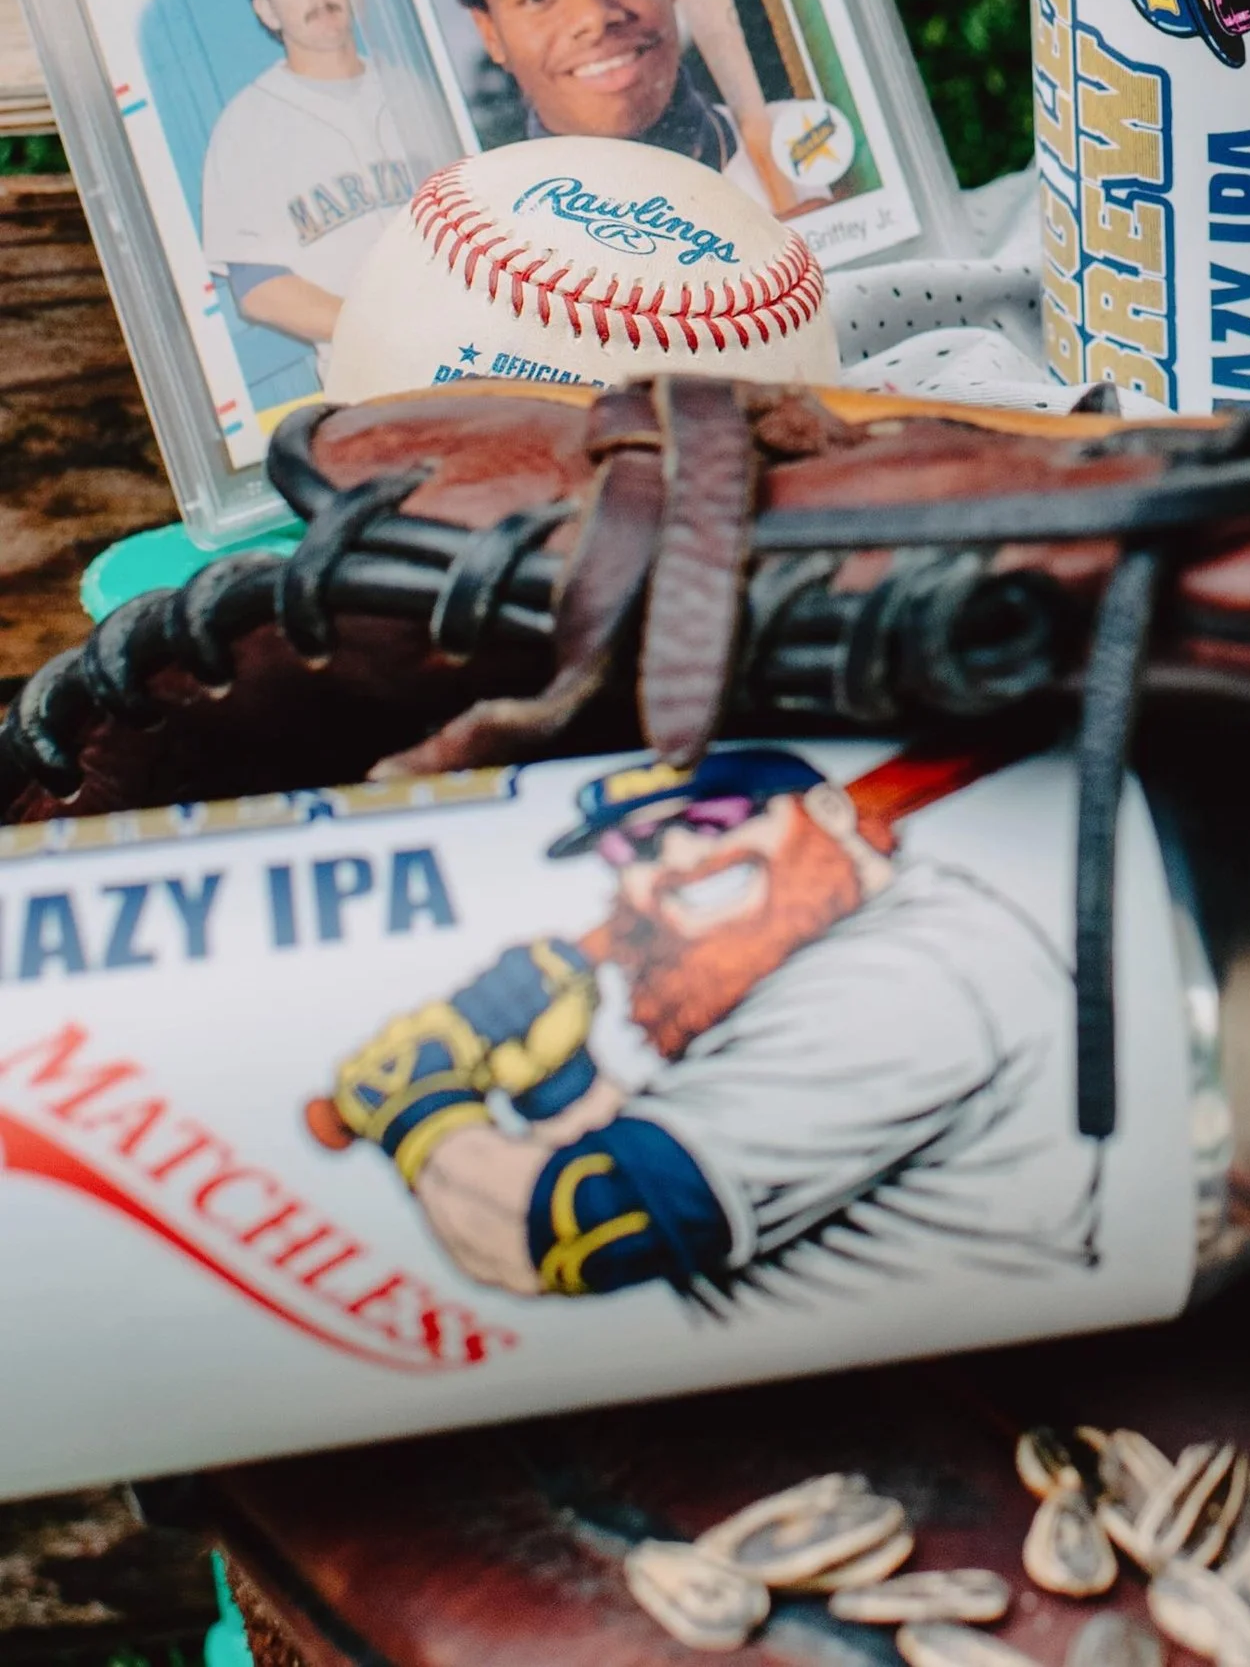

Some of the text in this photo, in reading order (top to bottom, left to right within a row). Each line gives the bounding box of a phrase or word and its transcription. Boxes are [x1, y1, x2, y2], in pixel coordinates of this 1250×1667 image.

[288, 160, 414, 248] MARIN
[512, 177, 741, 266] Rawlings
[0, 846, 459, 981] AZY IPA
[0, 1020, 518, 1366] MATCHLESS
